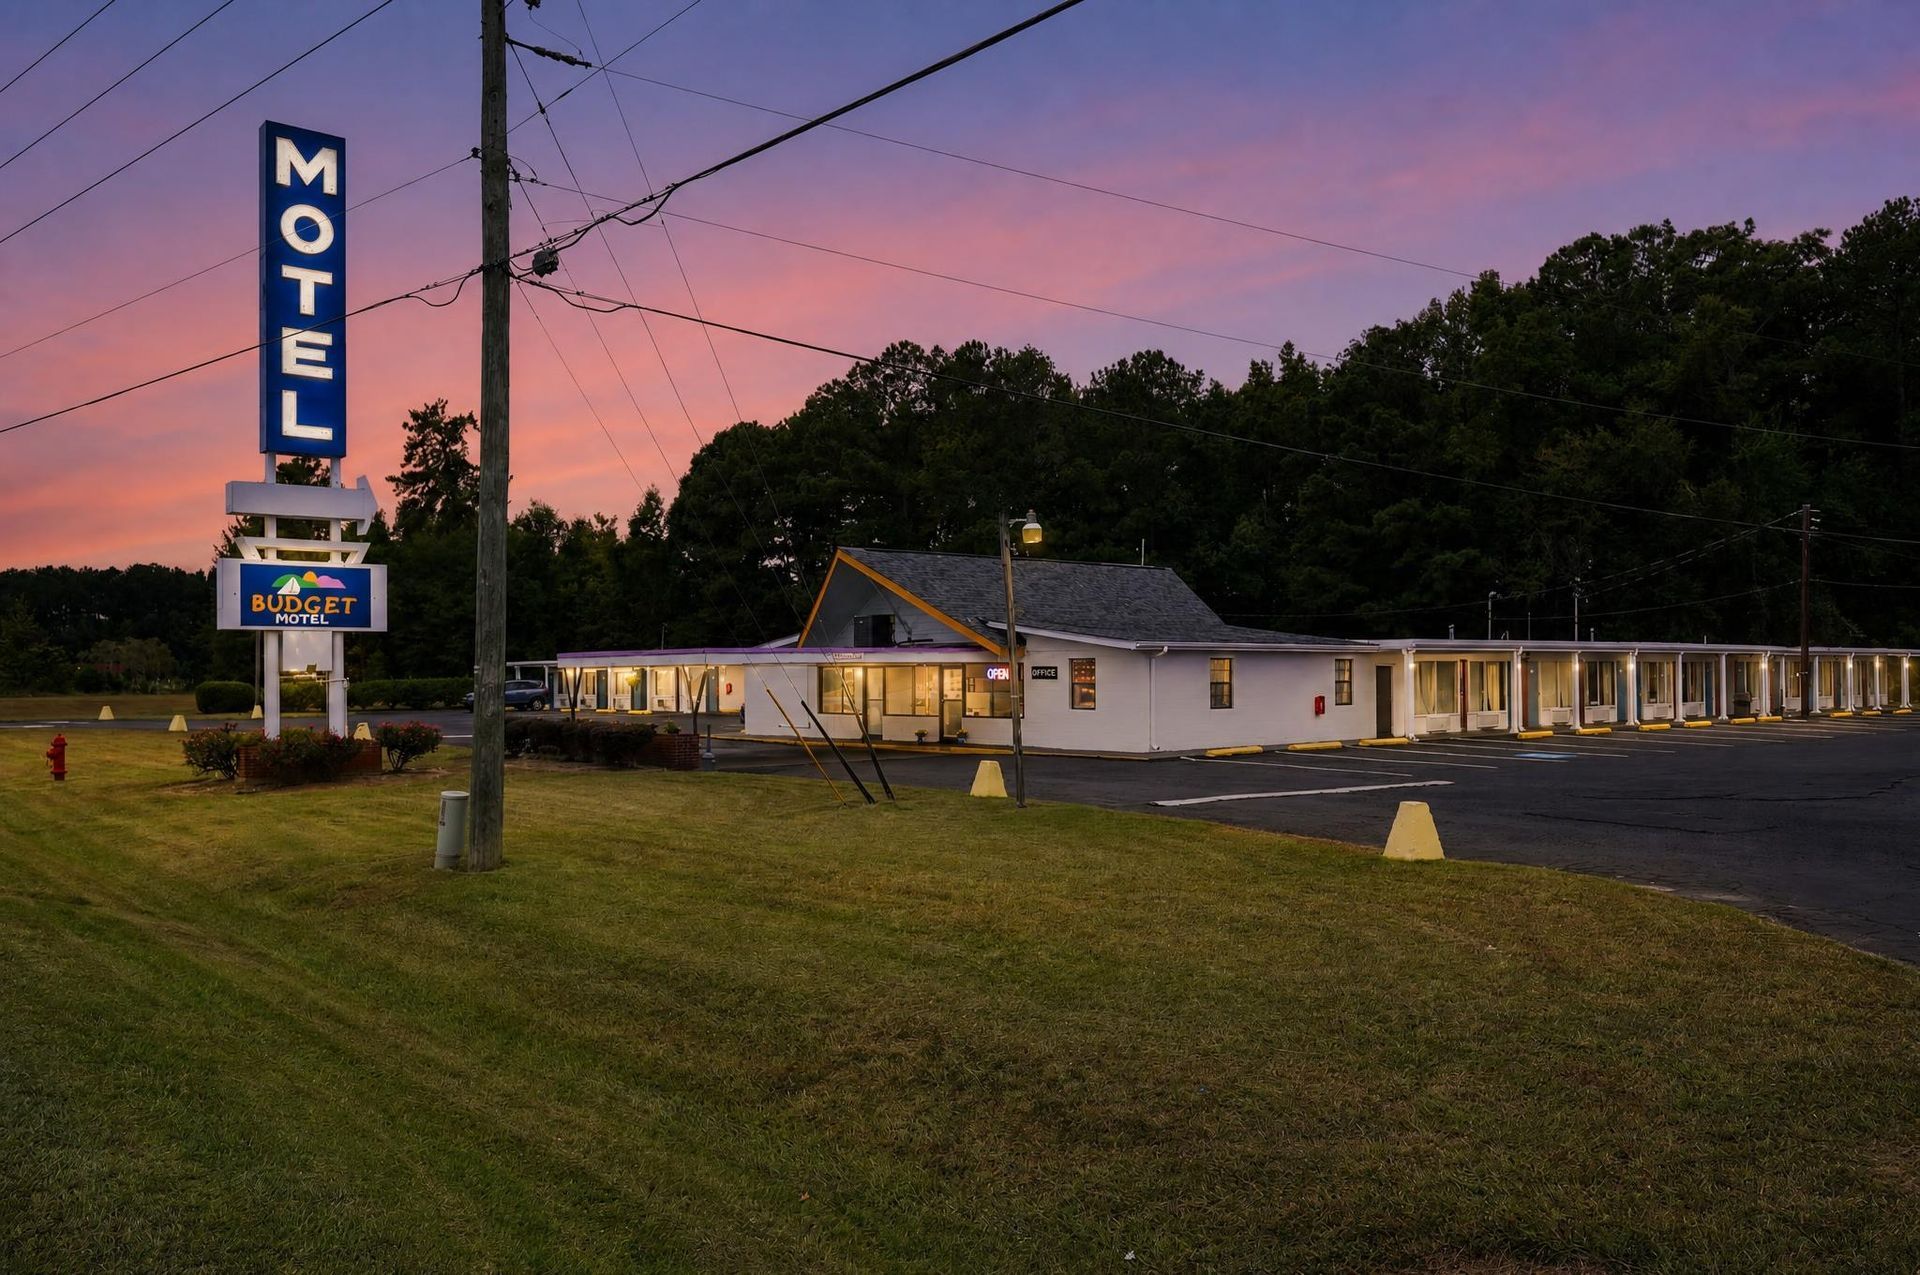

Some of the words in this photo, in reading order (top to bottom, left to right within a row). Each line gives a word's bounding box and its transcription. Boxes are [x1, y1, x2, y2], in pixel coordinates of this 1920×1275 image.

[275, 136, 338, 441] MOTEL
[251, 594, 358, 614] BUDGET
[275, 613, 329, 625] MOTEL
[987, 668, 1009, 680] OPEN
[1032, 669, 1056, 677] OFFICE
